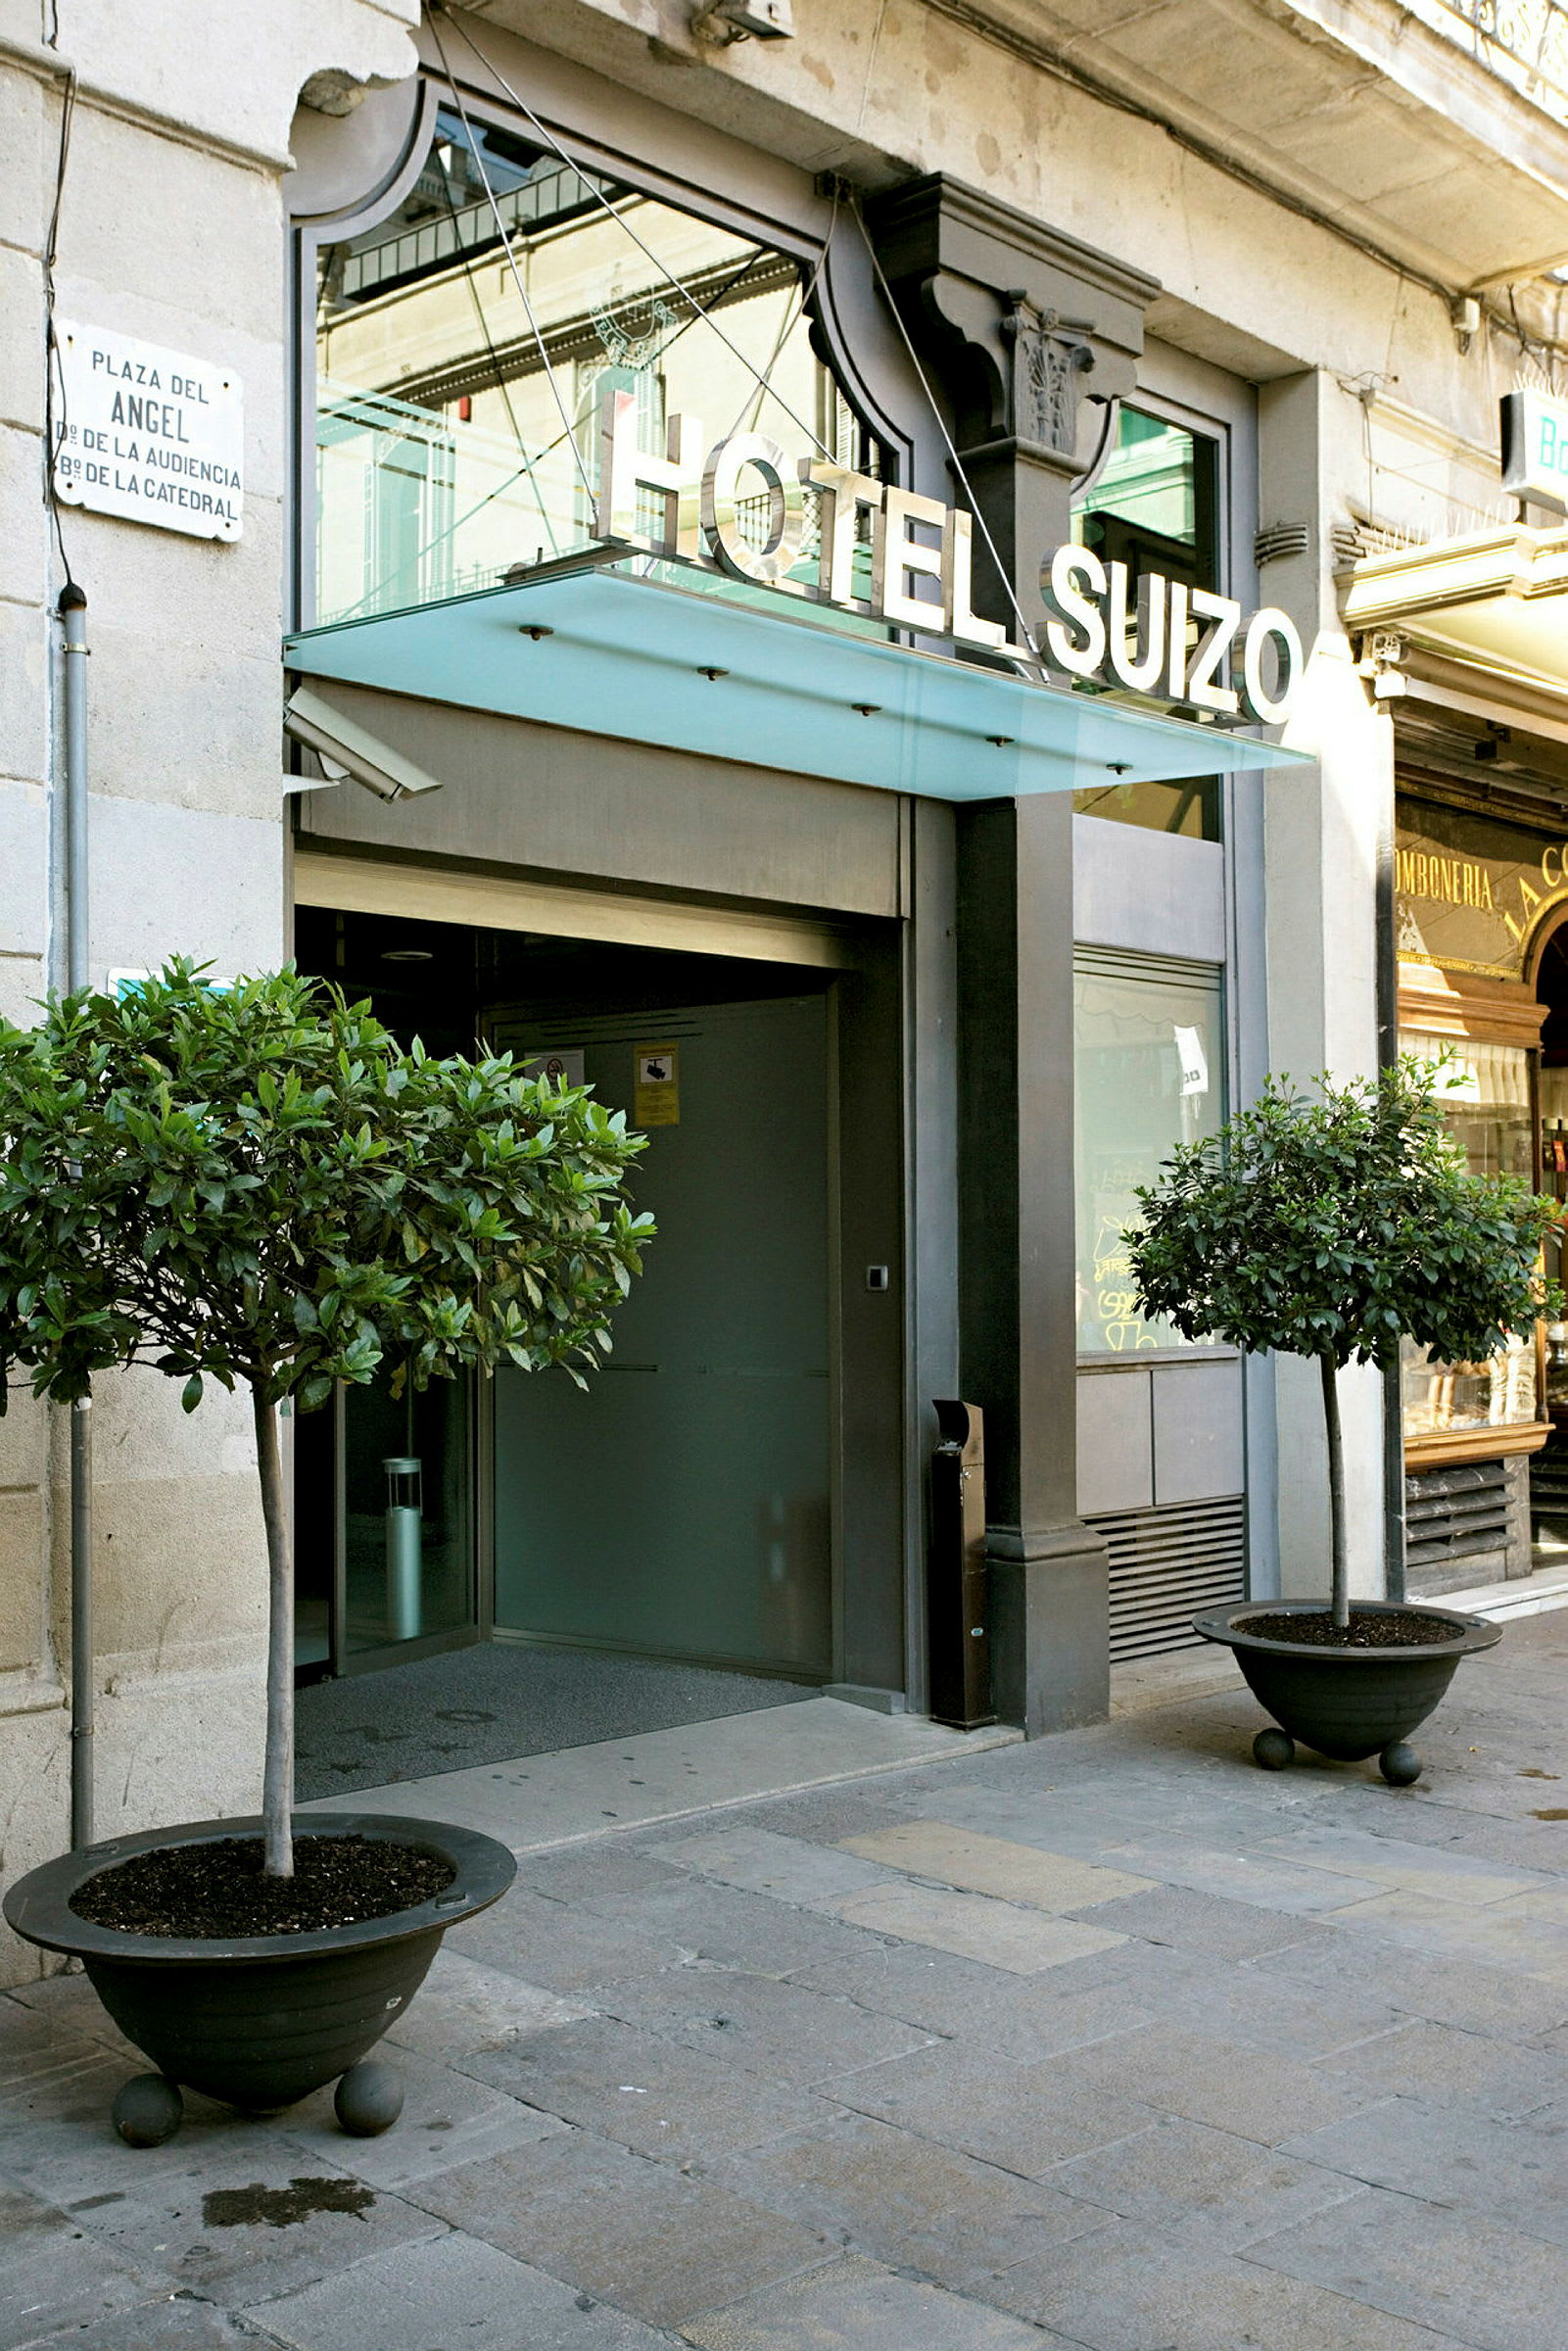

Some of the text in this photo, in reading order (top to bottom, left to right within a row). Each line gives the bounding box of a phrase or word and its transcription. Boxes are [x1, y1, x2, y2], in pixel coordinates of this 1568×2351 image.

[92, 351, 210, 405] PLAZA DEL
[111, 391, 189, 444] ANGEL
[83, 428, 108, 453] DE
[115, 437, 139, 461] LA
[146, 448, 241, 490] AUDIENCIA
[86, 461, 110, 487] DE
[116, 469, 139, 495] LA
[144, 478, 238, 520] CATEDRAL
[600, 388, 1305, 725] HOTEL SUIZO
